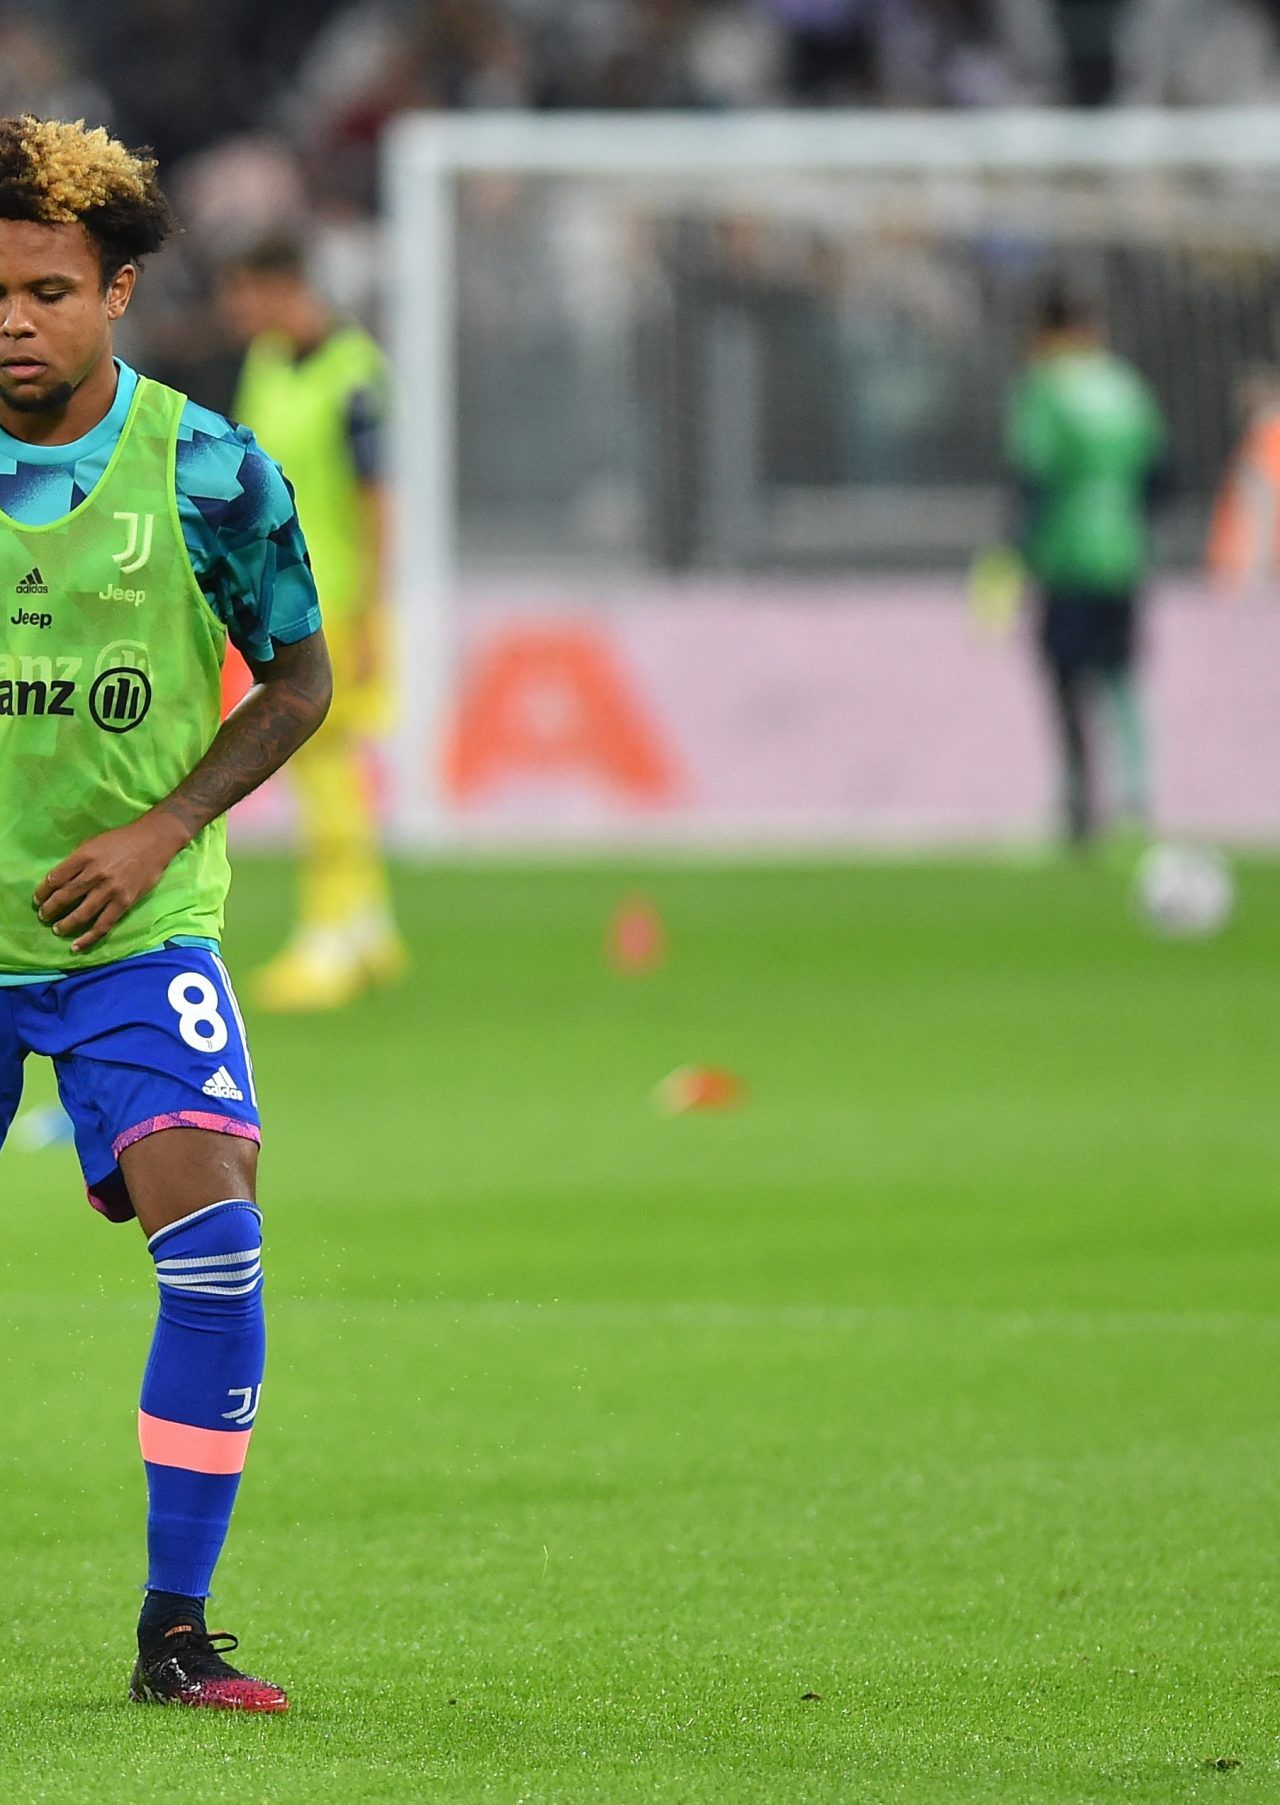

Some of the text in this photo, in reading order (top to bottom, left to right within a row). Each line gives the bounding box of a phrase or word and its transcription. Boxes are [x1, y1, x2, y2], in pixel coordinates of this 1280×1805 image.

[15, 583, 48, 595] adidas
[98, 583, 146, 608] Jeep
[10, 608, 52, 629] Jeep
[167, 971, 228, 1053] 8
[202, 1084, 243, 1101] adidas
